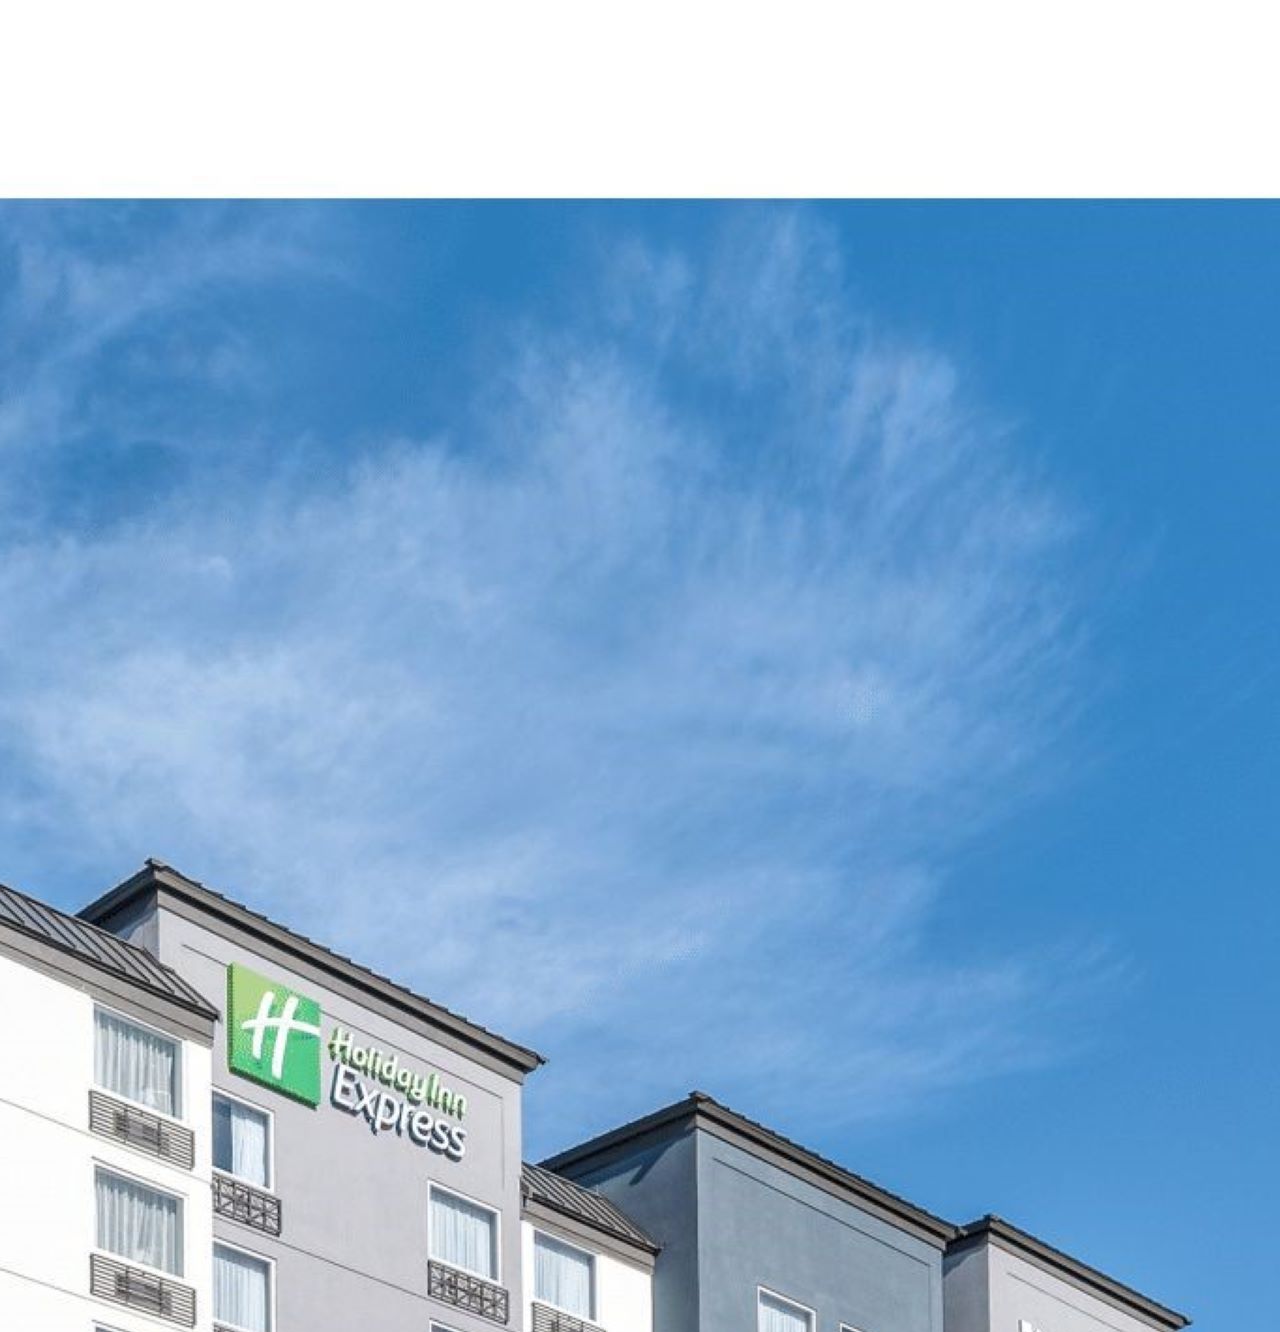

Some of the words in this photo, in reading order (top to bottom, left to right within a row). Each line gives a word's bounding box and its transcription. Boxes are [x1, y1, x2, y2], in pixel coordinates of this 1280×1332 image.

[329, 1027, 428, 1105] Holiday
[427, 1073, 467, 1120] Inn
[331, 1063, 467, 1162] Express
